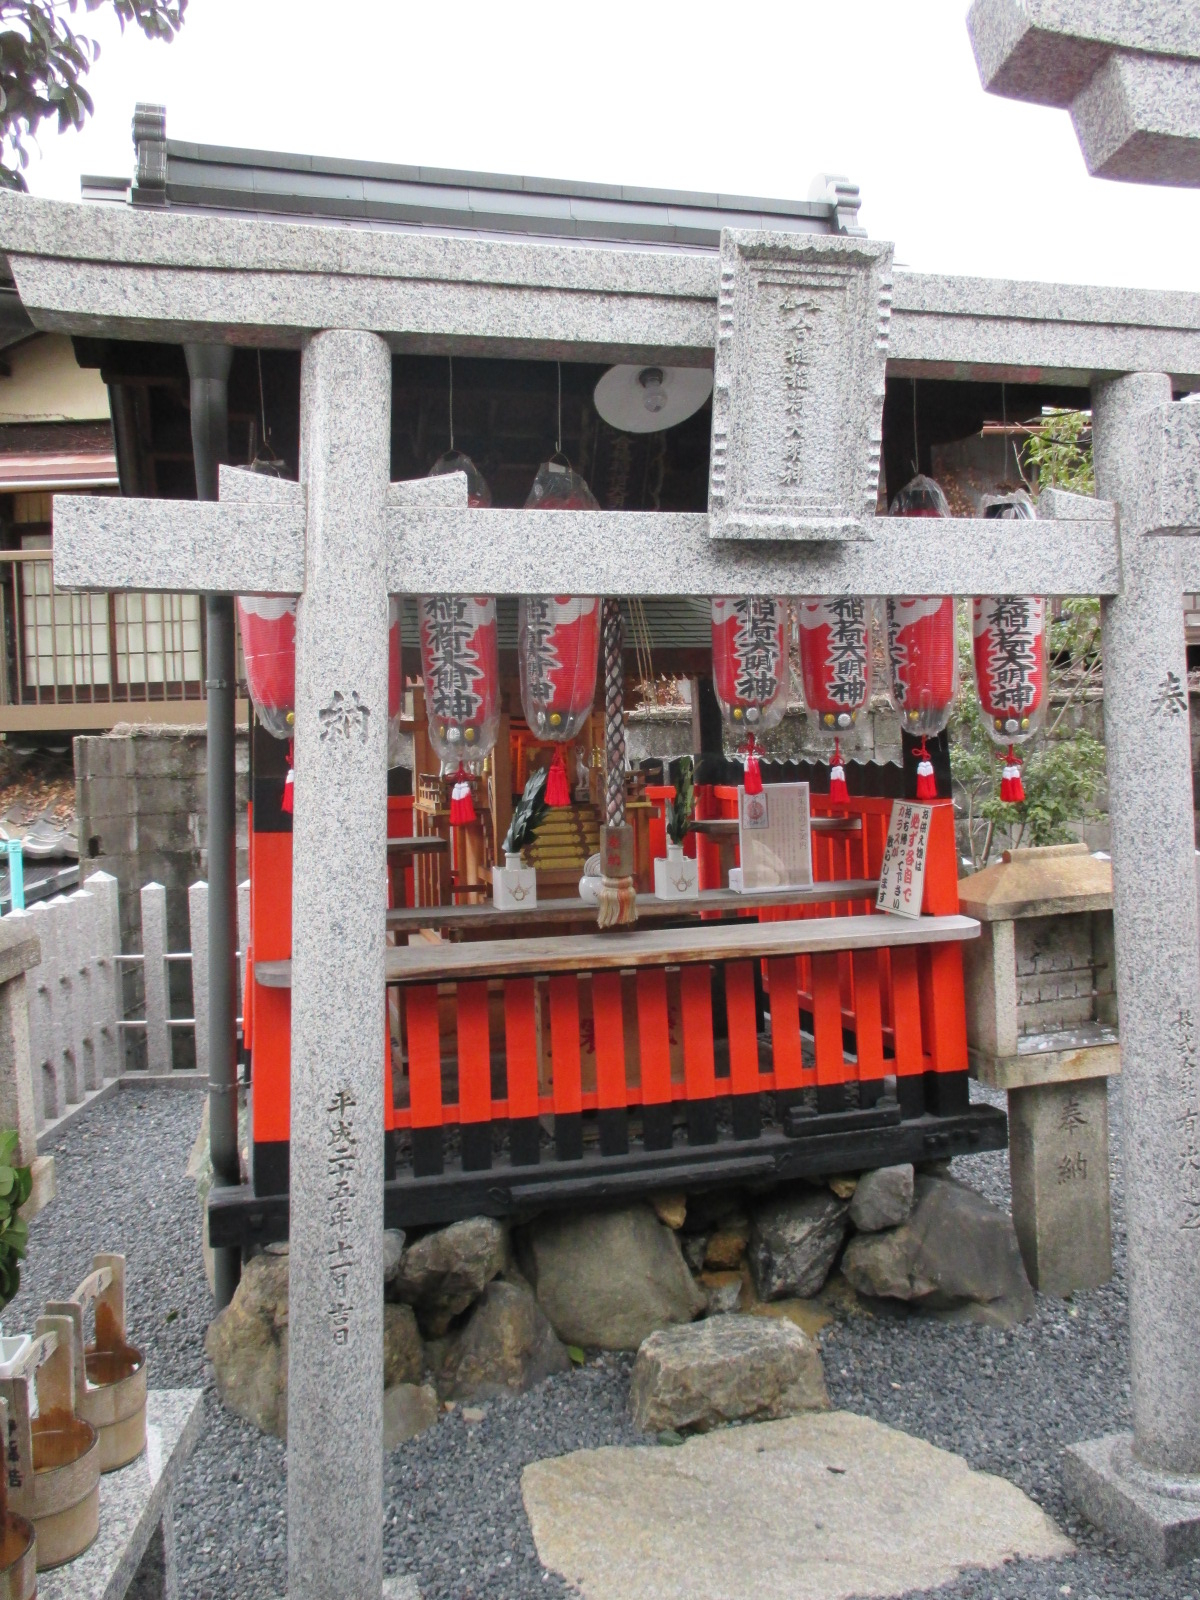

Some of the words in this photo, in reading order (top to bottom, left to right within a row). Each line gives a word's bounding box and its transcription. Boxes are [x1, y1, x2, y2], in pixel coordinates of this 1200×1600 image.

[319, 690, 370, 745] 納
[891, 805, 905, 857] カラスが
[893, 807, 912, 909] 持ち帰って下さい
[903, 813, 920, 904] 必ず各自で
[915, 809, 929, 872] お供え物は
[1058, 1099, 1087, 1185] 奉納
